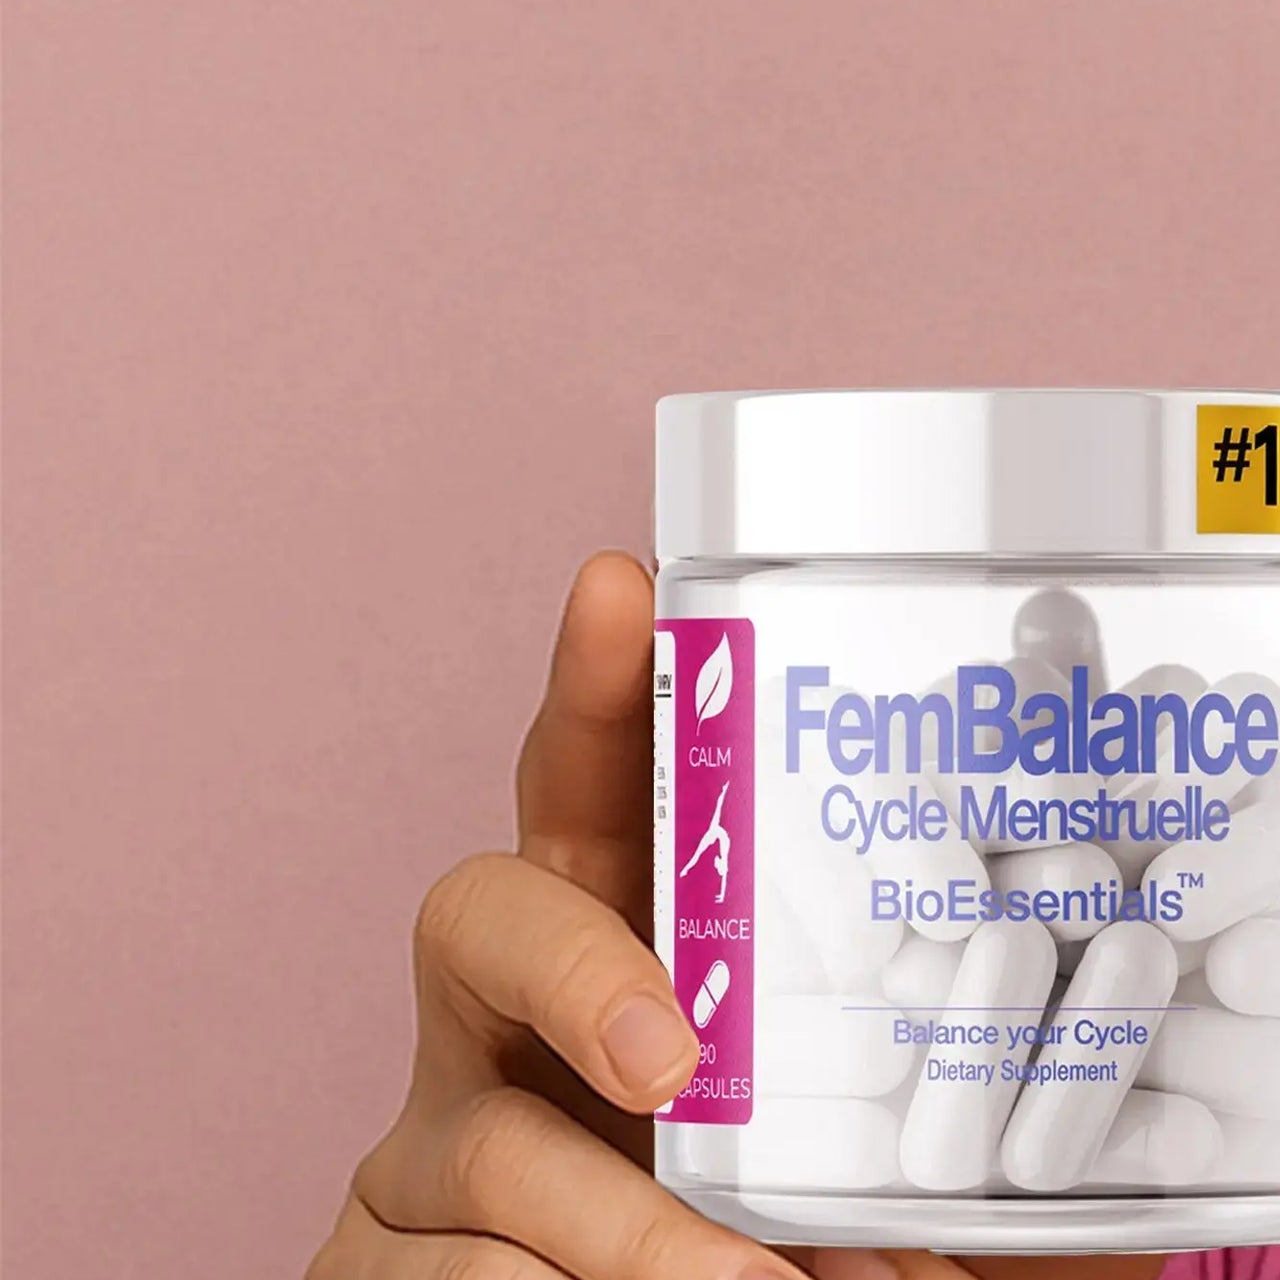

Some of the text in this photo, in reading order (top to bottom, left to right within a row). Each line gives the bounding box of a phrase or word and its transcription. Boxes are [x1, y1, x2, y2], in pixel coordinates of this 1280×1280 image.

[1212, 424, 1278, 506] #1
[785, 665, 1279, 776] FemBalance
[689, 746, 732, 768] CALM
[821, 784, 1231, 855] Cycle Menstruelle
[679, 918, 751, 940] BALANCE
[893, 1020, 1149, 1051] Balance your Cycle
[699, 1043, 717, 1065] 90
[927, 1059, 1118, 1086] Dietary Supplement
